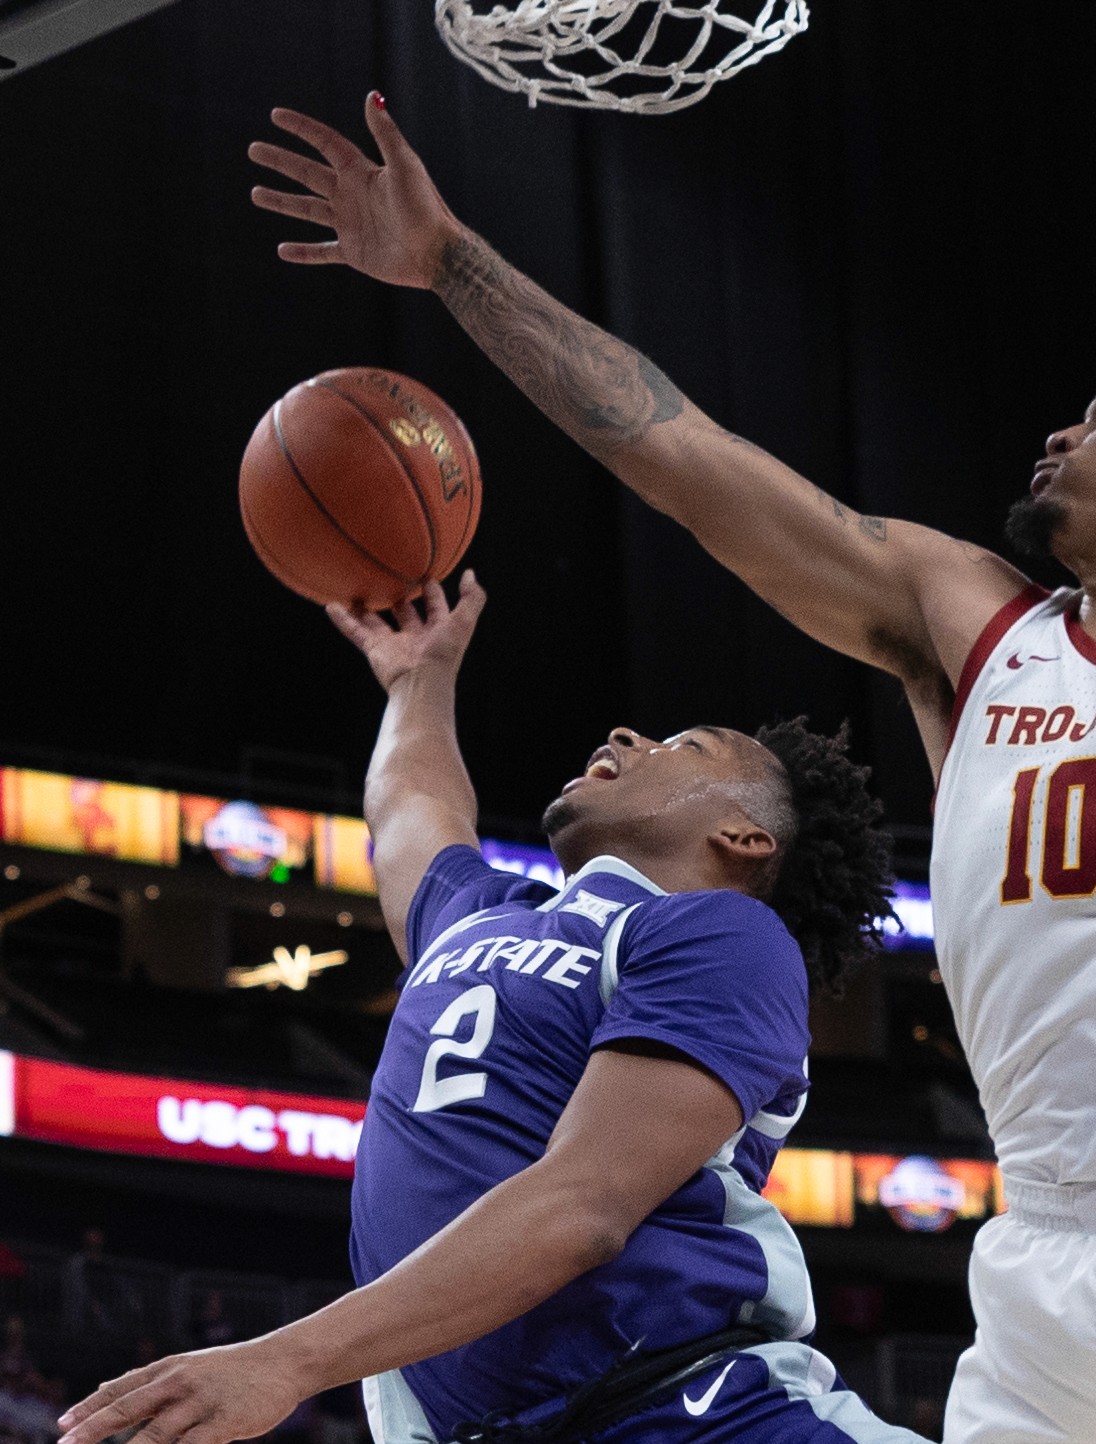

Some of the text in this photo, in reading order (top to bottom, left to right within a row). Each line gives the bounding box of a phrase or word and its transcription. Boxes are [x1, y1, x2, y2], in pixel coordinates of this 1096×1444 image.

[411, 935, 602, 990] K-STATE
[412, 984, 497, 1112] 2
[157, 1095, 278, 1153] USC
